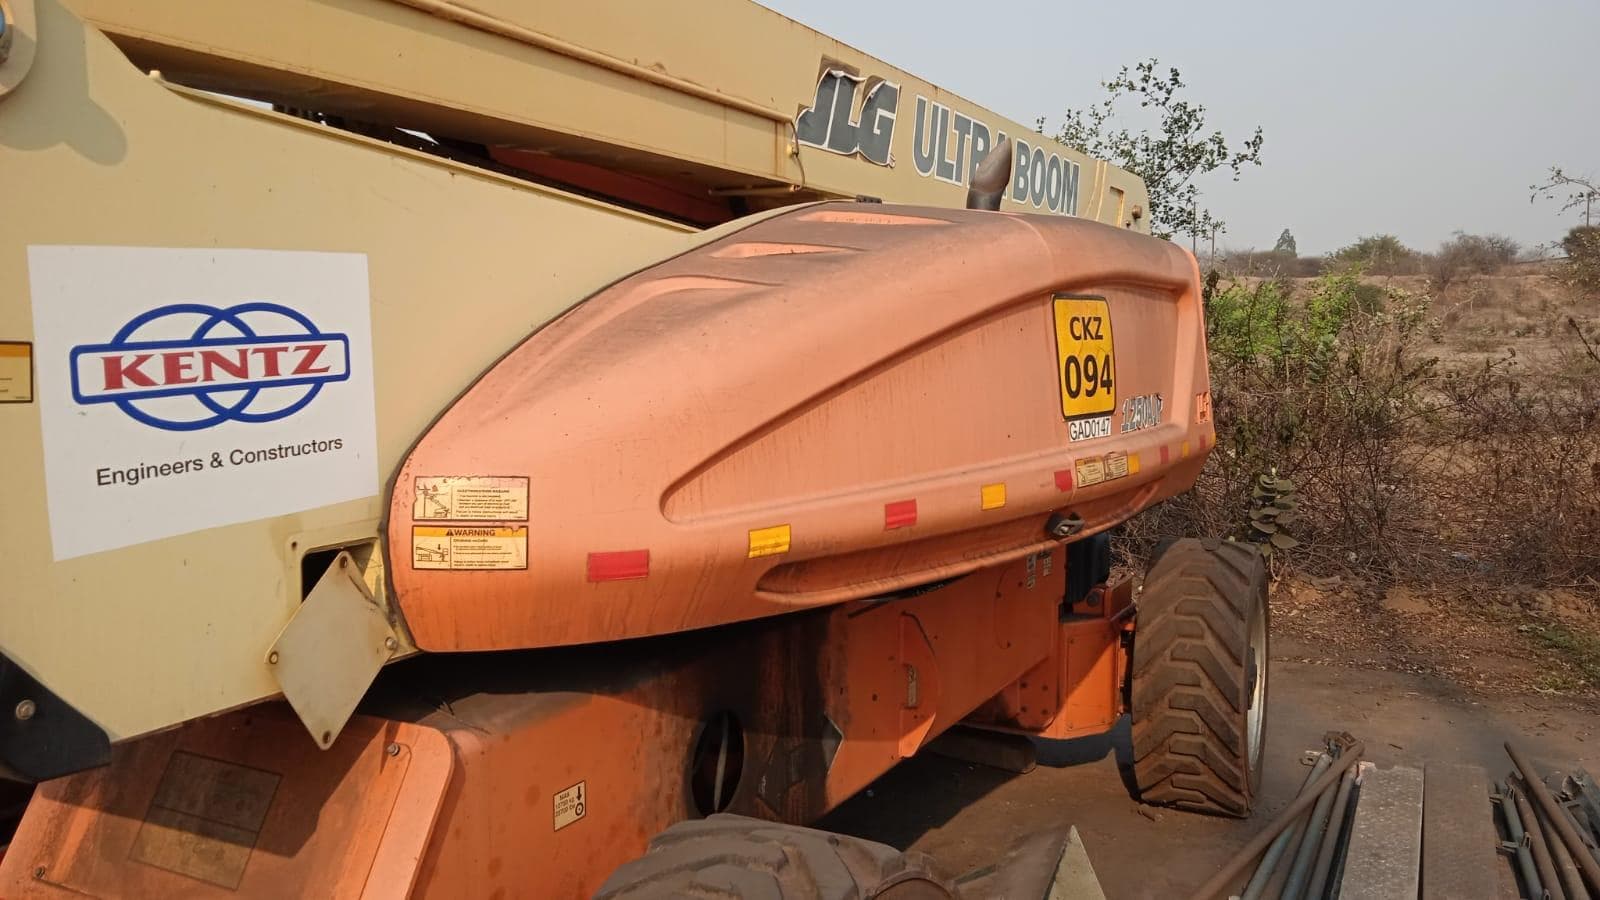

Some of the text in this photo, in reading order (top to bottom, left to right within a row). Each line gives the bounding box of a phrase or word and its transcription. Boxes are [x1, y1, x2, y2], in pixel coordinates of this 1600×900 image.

[793, 67, 901, 166] JLG
[913, 95, 1081, 217] ULTR BOOM
[1069, 316, 1104, 341] CKZ
[101, 344, 331, 391] KENTZ
[1064, 354, 1113, 399] 094
[1069, 418, 1110, 441] GAD0147
[96, 437, 343, 486] Engineers & Constructors
[454, 528, 496, 537] WARNING
